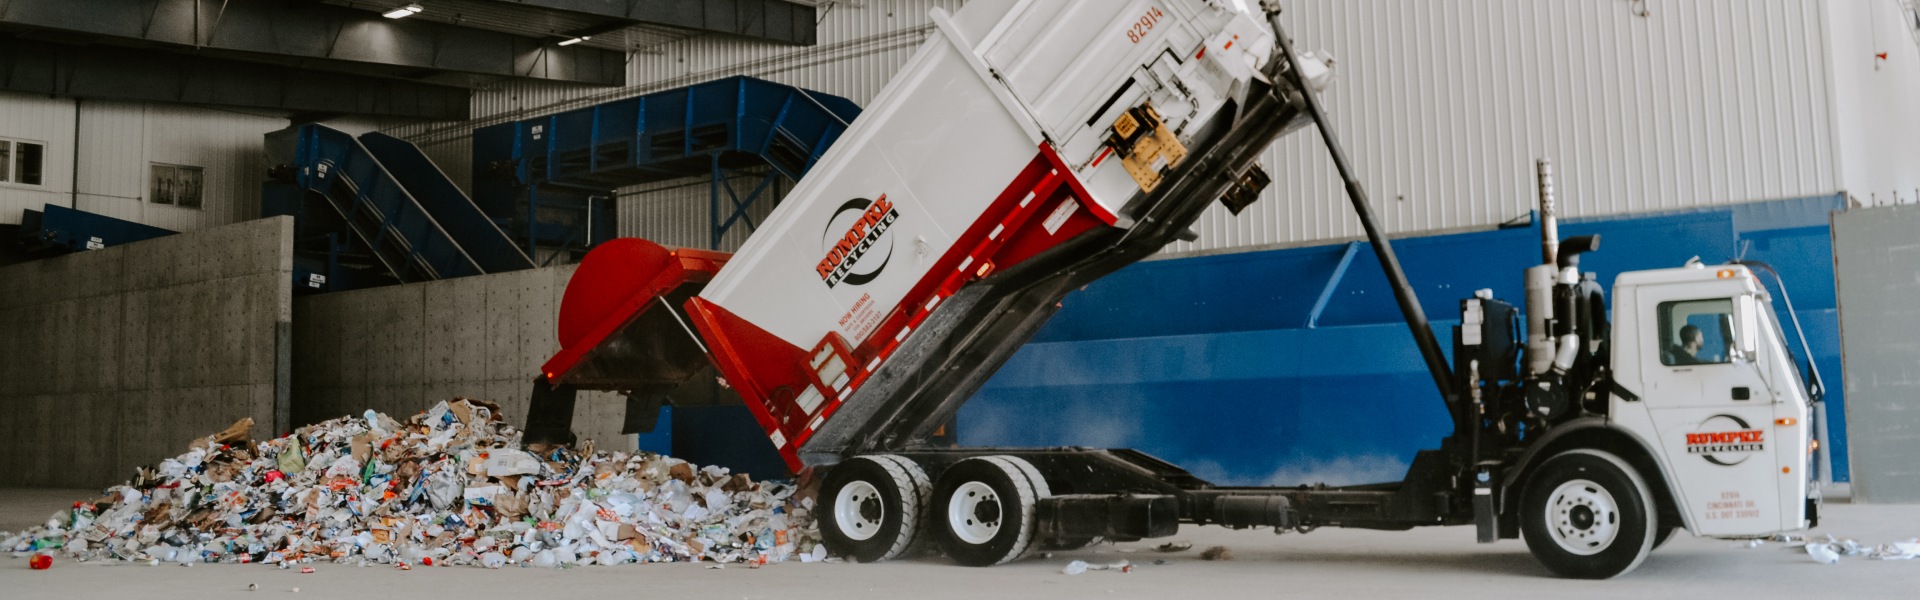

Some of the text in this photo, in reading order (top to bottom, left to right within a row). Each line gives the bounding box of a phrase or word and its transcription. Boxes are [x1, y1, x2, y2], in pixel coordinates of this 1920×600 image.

[1126, 5, 1163, 44] 82914
[816, 193, 893, 281] RUMPKE
[829, 212, 896, 286] RECYCLING
[838, 293, 870, 326] NOW HIRING
[1686, 430, 1764, 444] RUMPKE
[1687, 444, 1764, 453] RECYCLING
